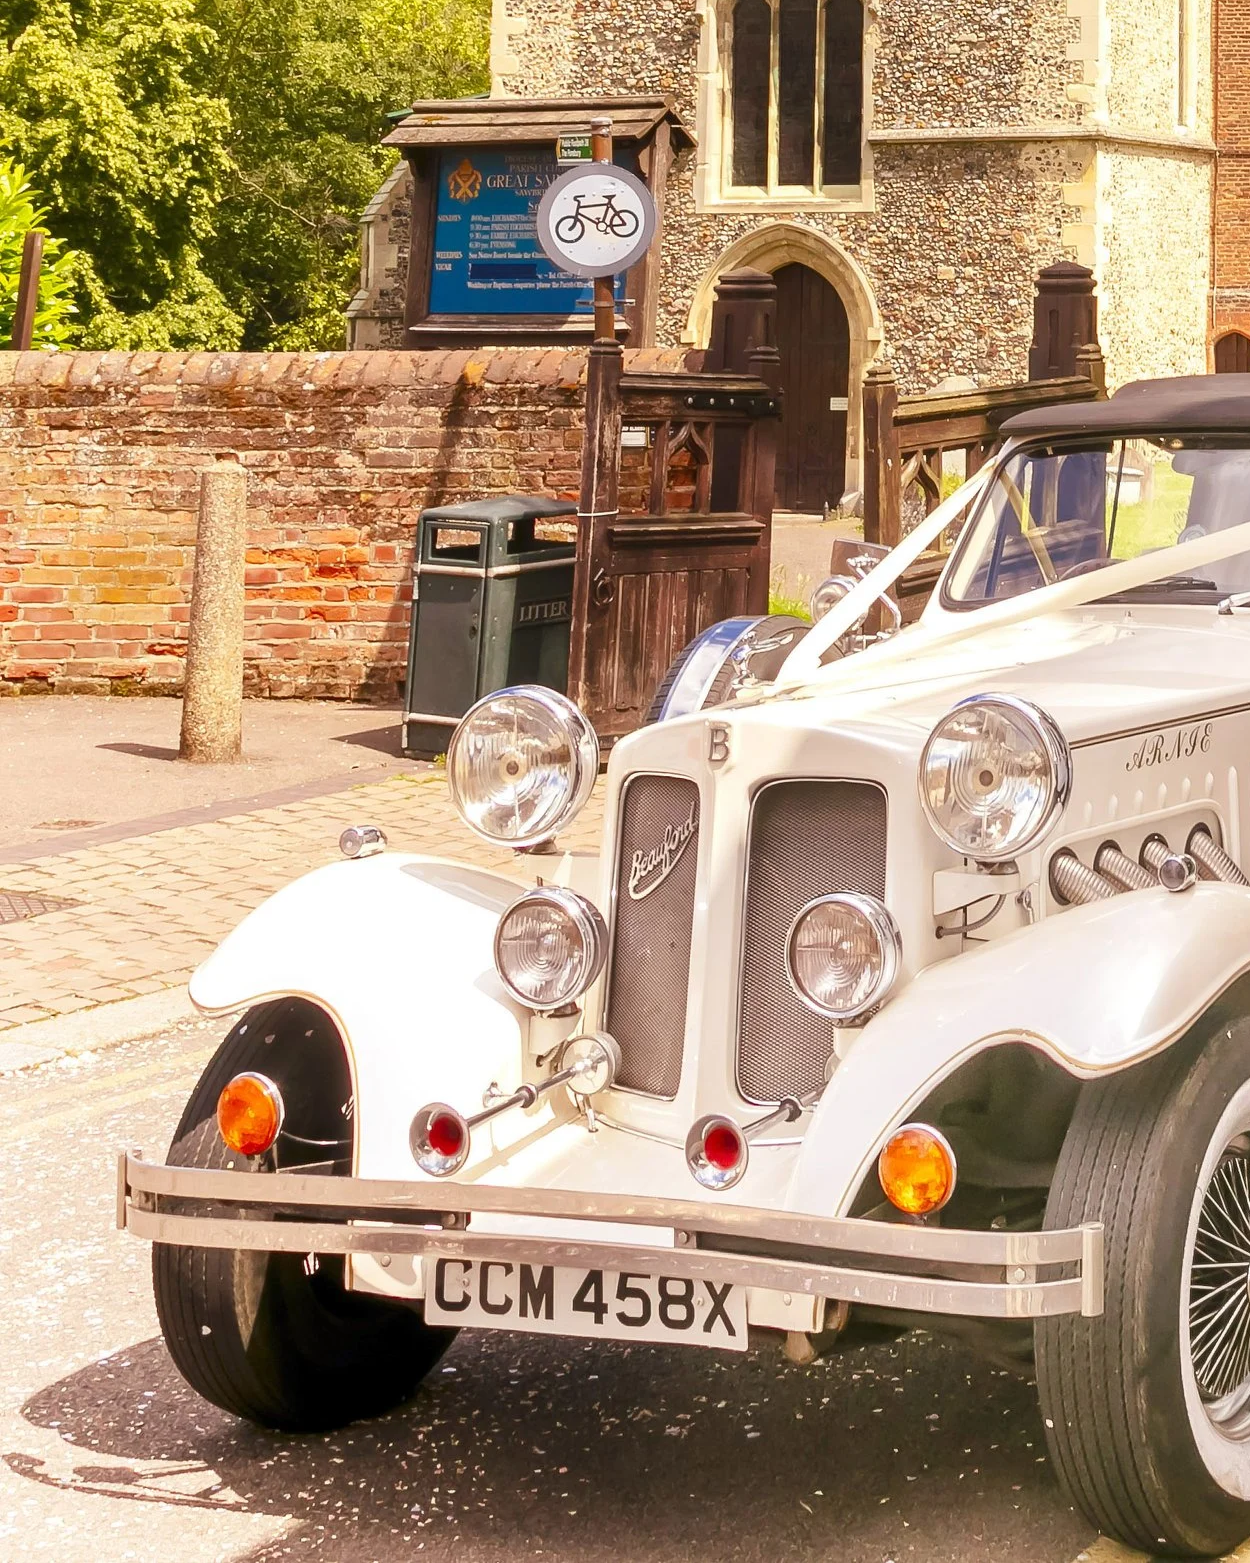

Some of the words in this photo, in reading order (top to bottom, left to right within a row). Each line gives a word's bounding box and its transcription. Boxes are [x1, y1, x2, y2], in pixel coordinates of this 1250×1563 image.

[486, 174, 529, 188] GREAT
[534, 174, 560, 188] SAI
[519, 600, 570, 622] LITTER
[708, 721, 731, 763] B
[1125, 722, 1214, 772] ARNIE
[628, 800, 699, 900] Beauford
[434, 1257, 555, 1320] CCM
[572, 1269, 737, 1337] 458X
